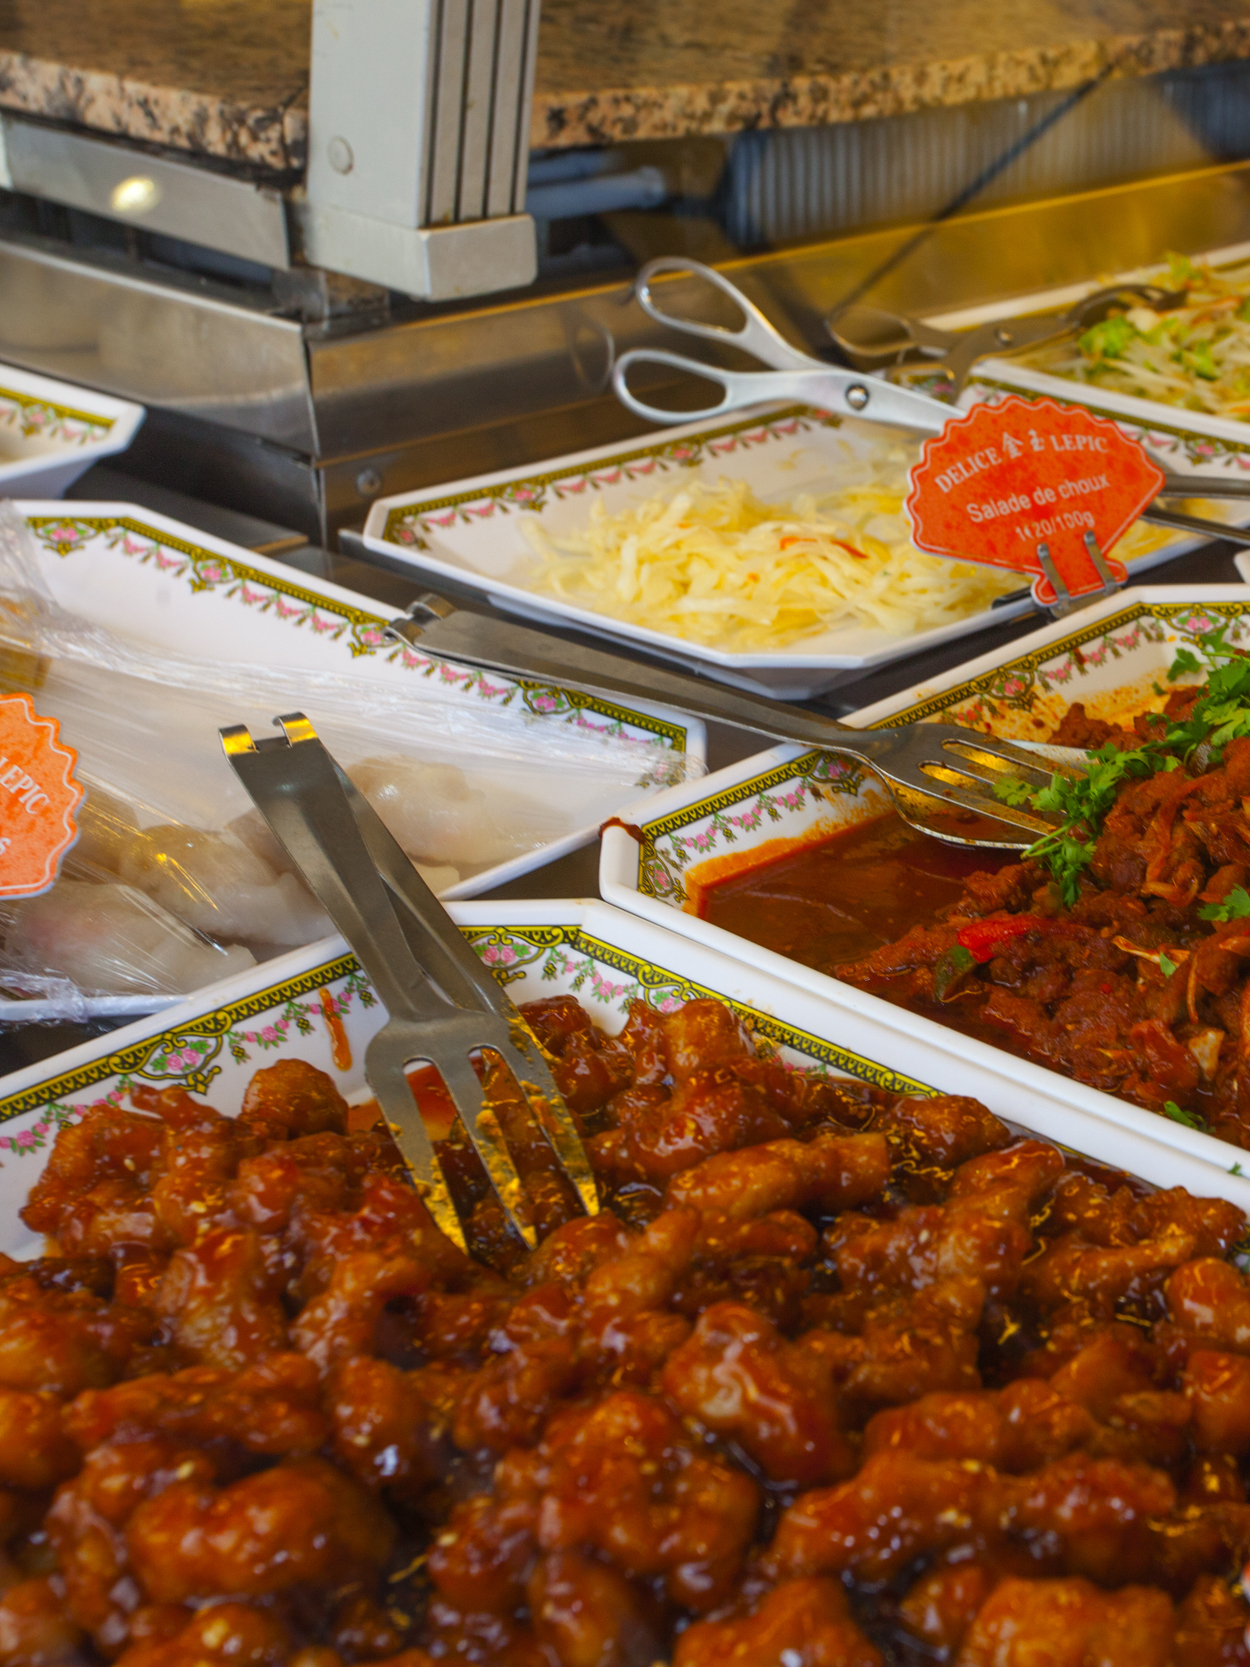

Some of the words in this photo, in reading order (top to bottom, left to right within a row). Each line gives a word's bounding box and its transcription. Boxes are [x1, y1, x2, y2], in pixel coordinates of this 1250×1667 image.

[934, 447, 1002, 494] DELICE
[1050, 434, 1109, 453] LEPIC
[966, 493, 1032, 523] Salade
[1033, 486, 1057, 506] de
[1058, 473, 1111, 500] choux
